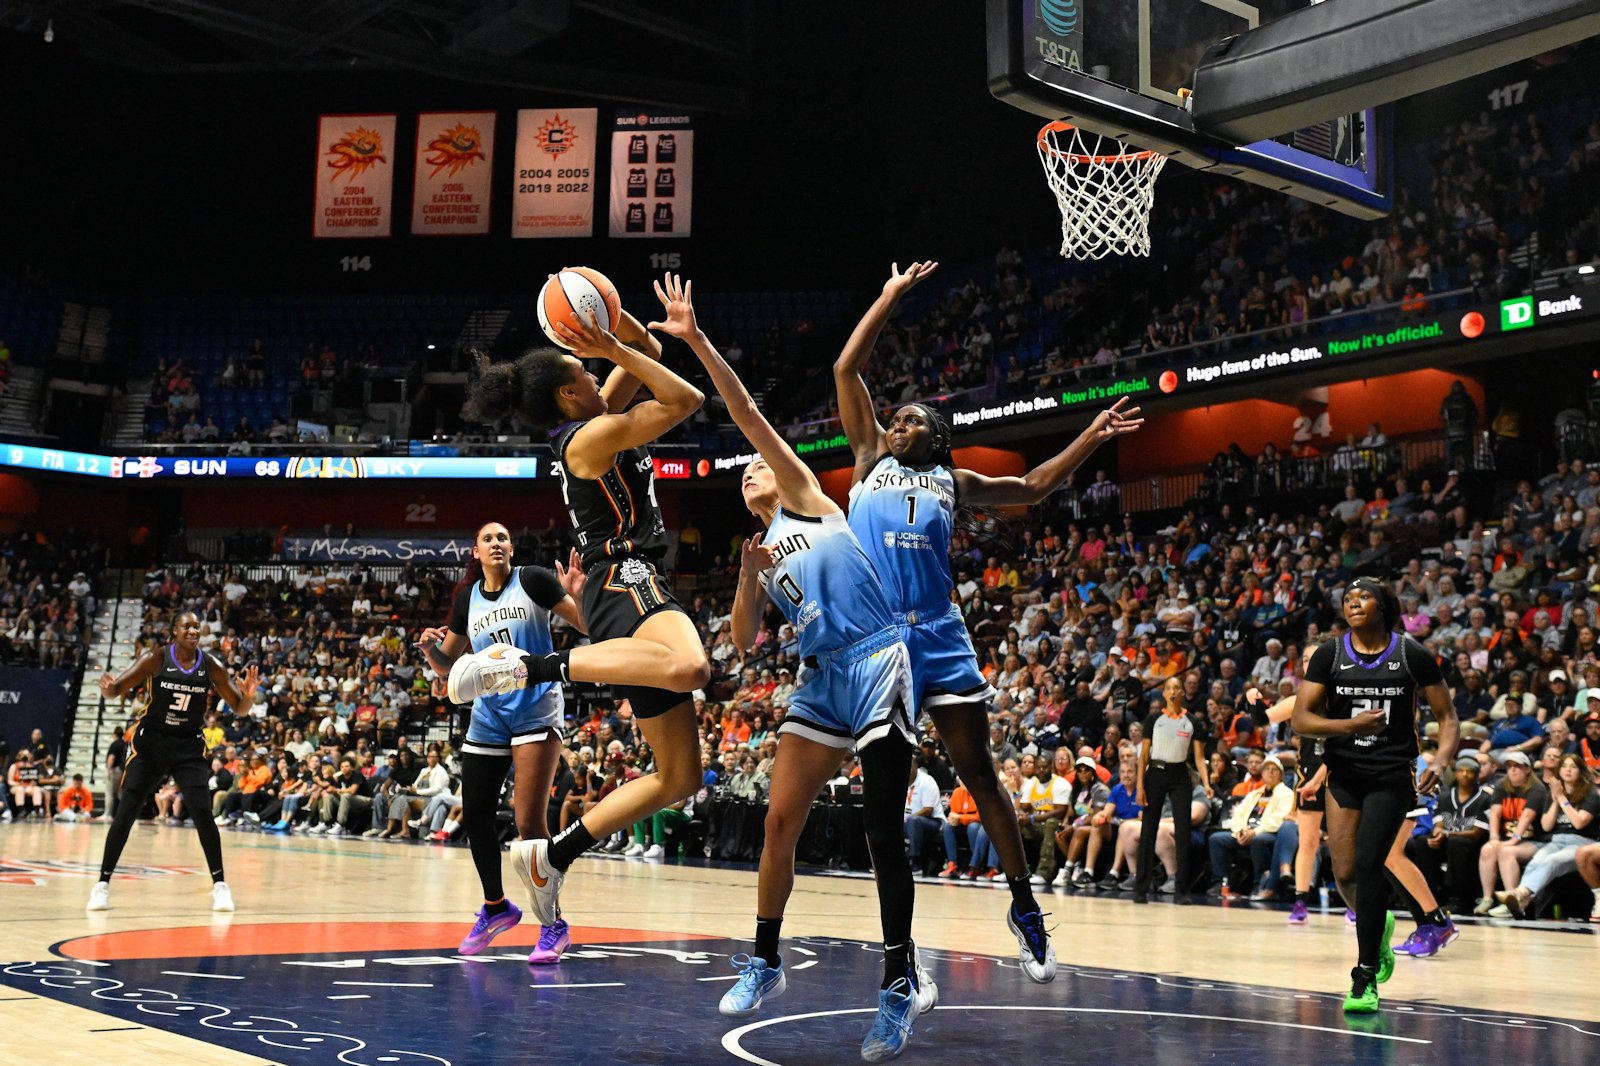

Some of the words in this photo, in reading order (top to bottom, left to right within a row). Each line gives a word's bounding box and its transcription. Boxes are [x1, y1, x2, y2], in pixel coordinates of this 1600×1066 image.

[1488, 80, 1529, 110] 117
[616, 117, 636, 125] SUN
[649, 116, 690, 124] LEGENDS
[632, 140, 644, 150] 12
[519, 169, 552, 179] 2004
[557, 168, 590, 178] 2005
[630, 173, 645, 184] 23
[659, 173, 671, 183] 13
[519, 184, 552, 193] 2019
[556, 183, 589, 192] 2022
[333, 197, 374, 206] EASTERN
[433, 194, 473, 203] EASTERN
[324, 207, 382, 217] CONFERENCE
[422, 204, 481, 214] CONFERENCE
[631, 209, 642, 219] 15
[326, 217, 379, 228] CHAMPIONS
[424, 215, 478, 225] CHAMPIONS
[340, 255, 372, 272] 114
[650, 253, 682, 269] 115
[1503, 302, 1532, 324] TD
[1538, 294, 1583, 317] Bank
[1328, 340, 1361, 356] Now
[1362, 333, 1385, 350] it's
[1386, 321, 1445, 345] official.
[1186, 366, 1221, 382] Huge
[1221, 360, 1251, 376] fans
[1251, 353, 1267, 370] of
[1266, 351, 1290, 368] the
[1290, 347, 1323, 363] Sun.
[1062, 391, 1088, 406] Now
[1088, 386, 1106, 401] it's
[1106, 376, 1151, 397] official.
[952, 411, 980, 426] Huge
[980, 406, 1004, 421] fans
[1003, 401, 1016, 417] of
[1015, 399, 1034, 414] the
[1033, 396, 1059, 411] Sun.
[1293, 412, 1332, 442] 24
[796, 439, 815, 455] Now
[816, 438, 829, 452] it's
[11, 450, 24, 464] 9
[42, 451, 64, 469] FTA
[76, 457, 99, 474] 12
[174, 460, 227, 476] SUN
[254, 460, 280, 477] 68
[372, 460, 424, 476] SKY
[494, 460, 520, 477] 62
[660, 463, 684, 475] 4TH
[714, 456, 735, 470] Huge
[405, 503, 437, 522] 22
[906, 494, 918, 526] 1
[309, 538, 393, 560] Mohegan
[395, 540, 436, 561] Sun
[778, 571, 805, 608] 0
[473, 606, 529, 638] SKYTOWN
[160, 680, 206, 693] KEESUSK
[1336, 685, 1405, 696] KEESUSK
[169, 692, 191, 711] 31
